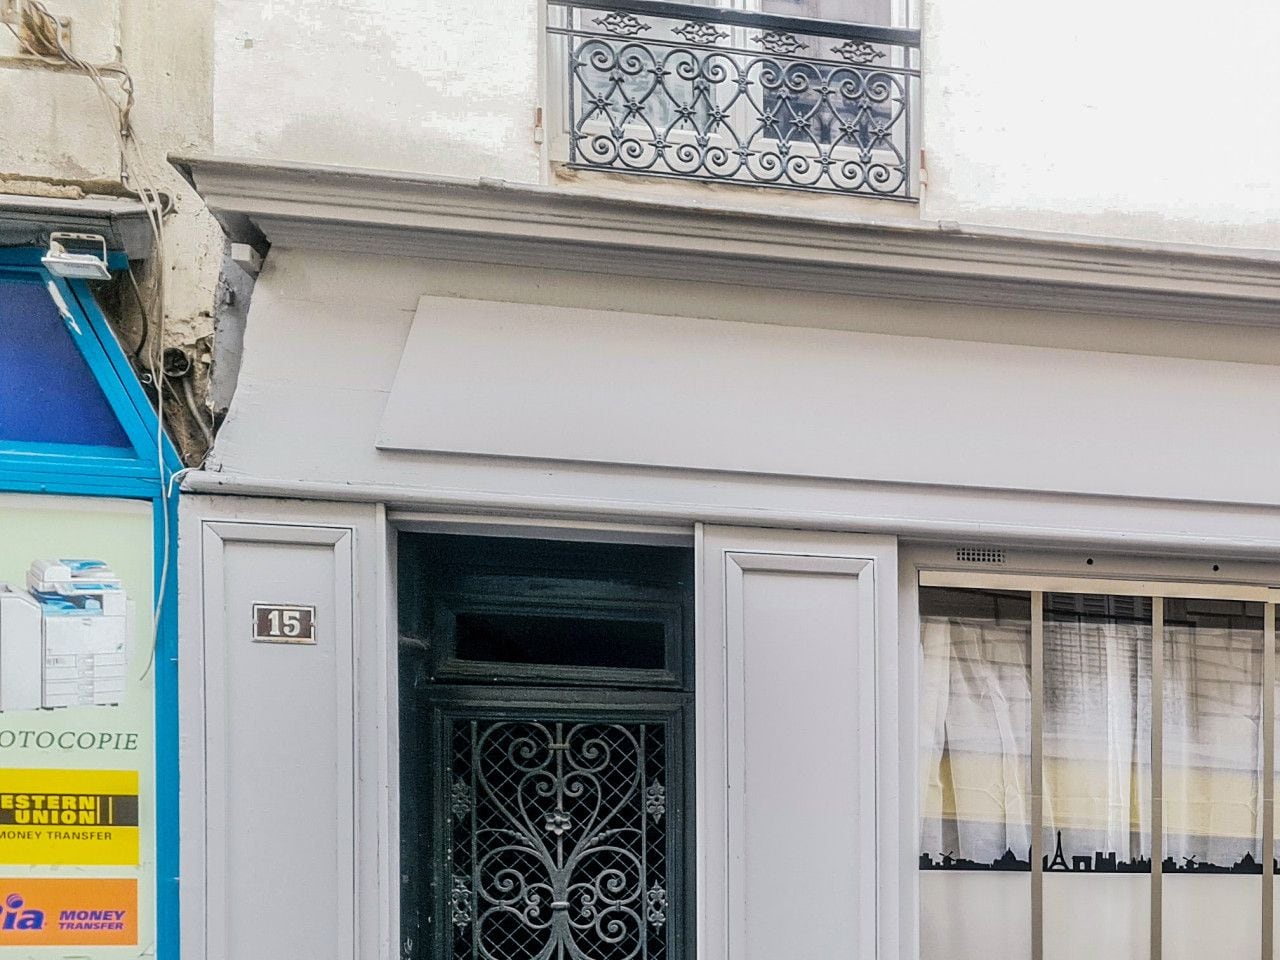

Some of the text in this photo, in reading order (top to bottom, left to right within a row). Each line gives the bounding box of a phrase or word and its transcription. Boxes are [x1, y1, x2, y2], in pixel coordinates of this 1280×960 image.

[268, 610, 300, 636] 15
[0, 730, 138, 750] OTOCOPIE
[15, 810, 95, 824] UNION
[47, 831, 112, 840] TRANSFER
[0, 893, 44, 930] ia
[60, 910, 125, 921] MONEY
[59, 922, 123, 930] TRANSFER
